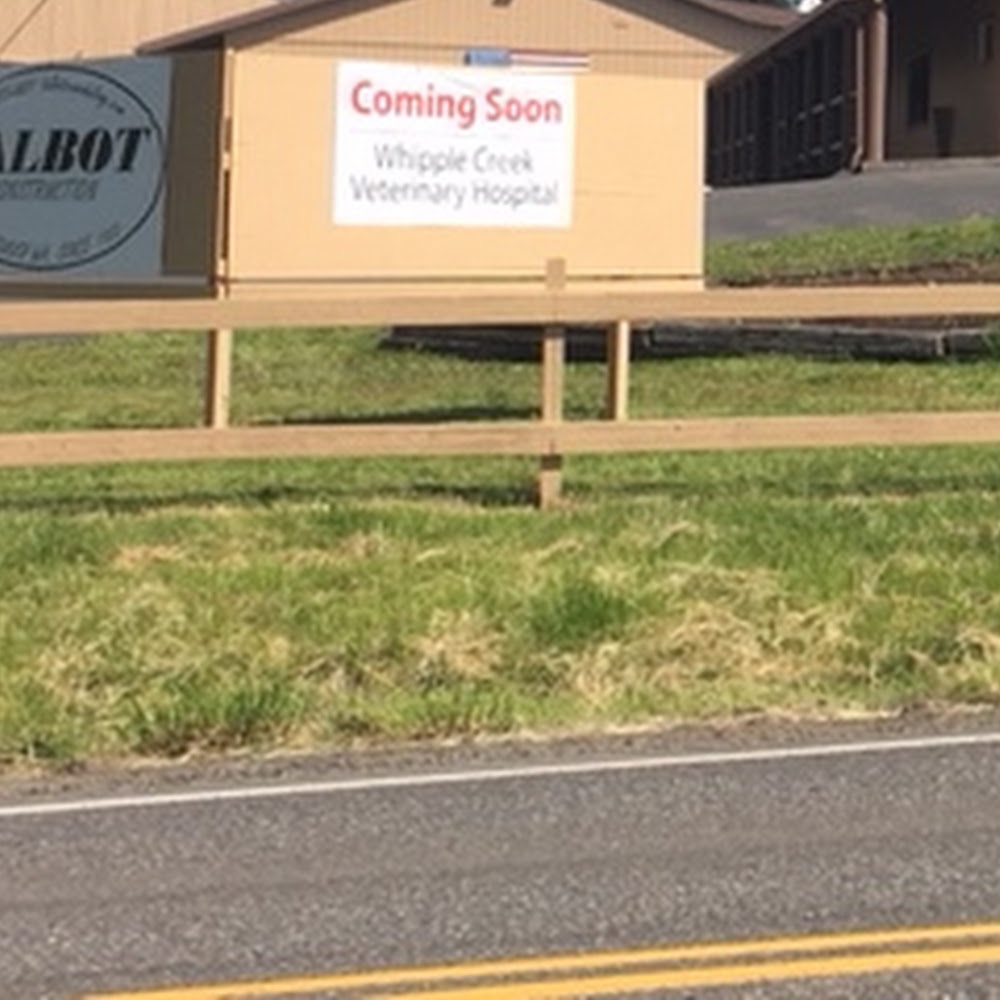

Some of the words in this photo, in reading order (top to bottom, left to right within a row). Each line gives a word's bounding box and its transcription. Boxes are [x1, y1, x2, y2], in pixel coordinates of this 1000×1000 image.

[351, 80, 477, 129] Coming
[485, 87, 563, 123] Soon
[0, 127, 152, 174] LBOT
[373, 143, 468, 175] Whipple
[472, 146, 533, 174] Creek
[349, 175, 467, 210] Veterinary
[471, 179, 559, 209] Hospital
